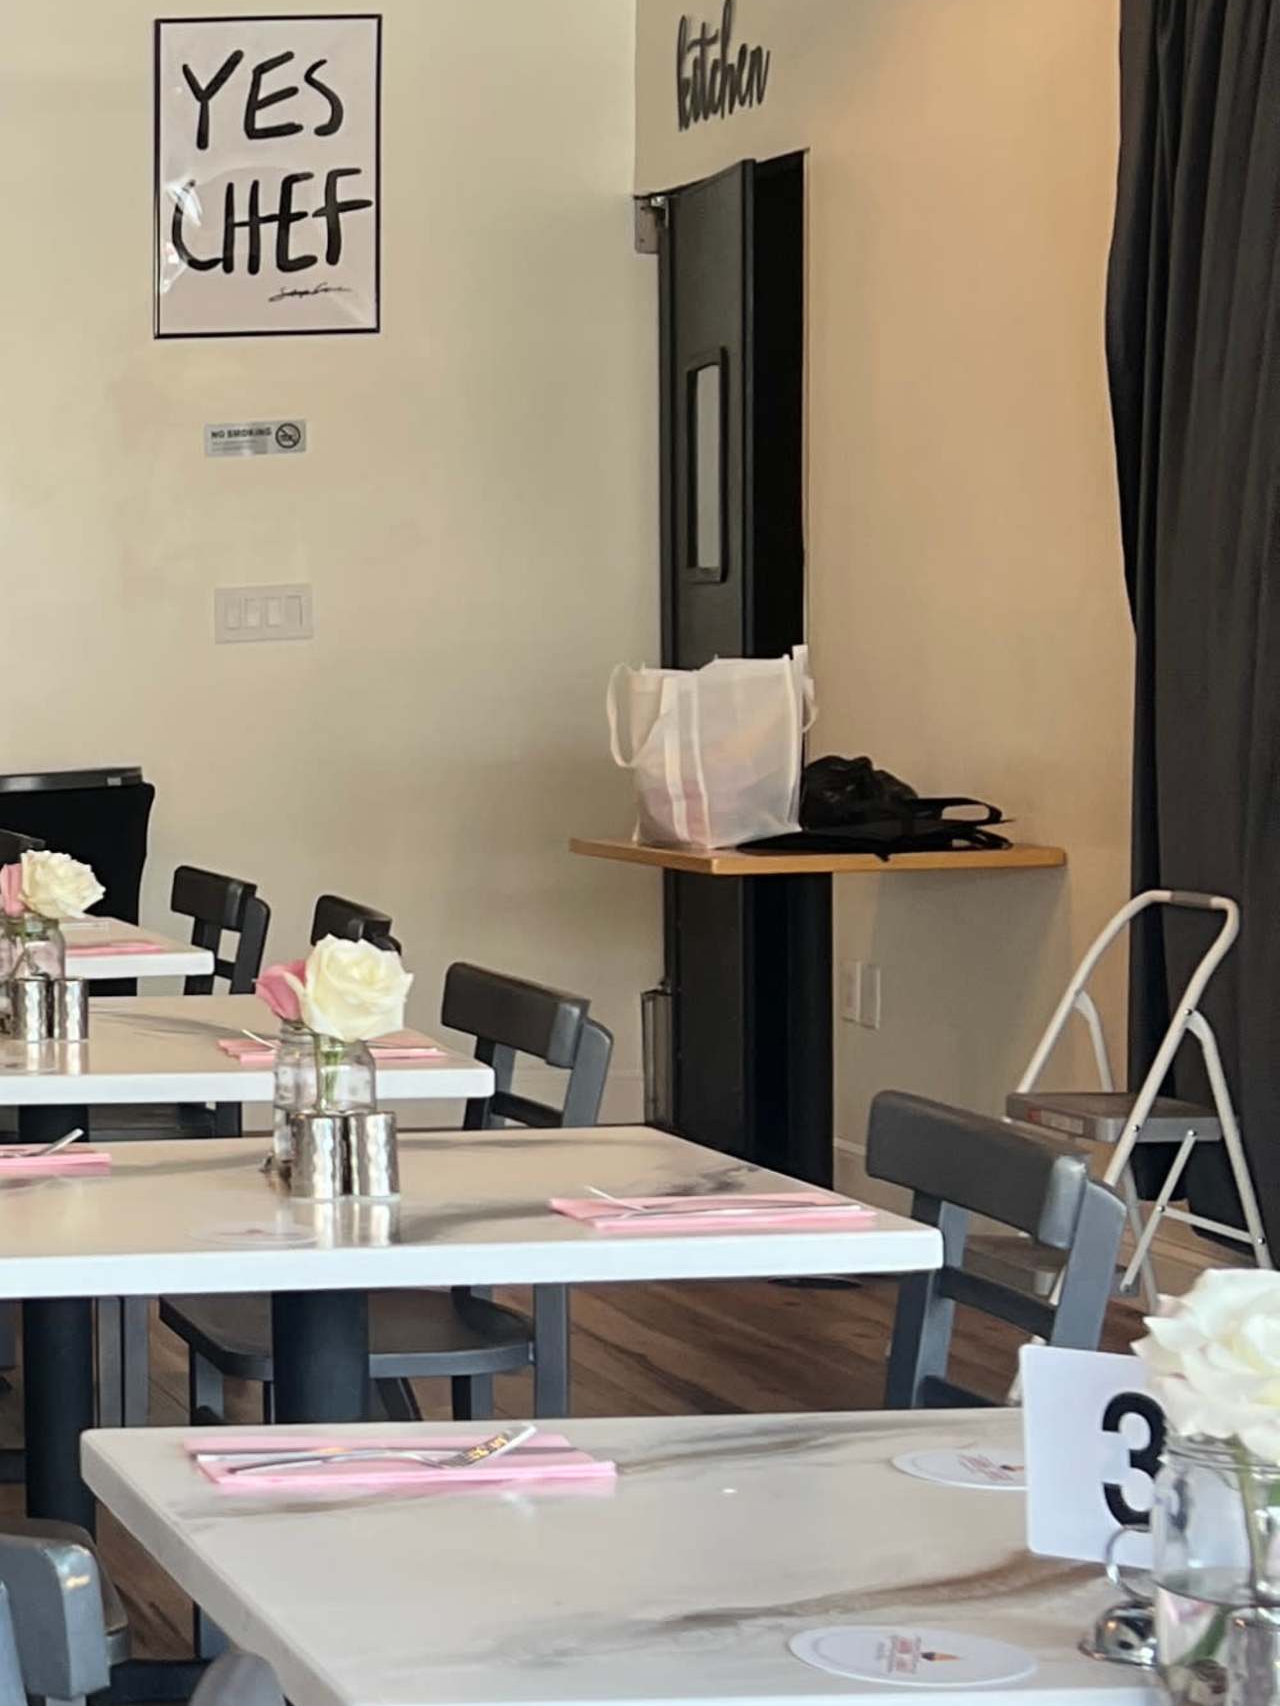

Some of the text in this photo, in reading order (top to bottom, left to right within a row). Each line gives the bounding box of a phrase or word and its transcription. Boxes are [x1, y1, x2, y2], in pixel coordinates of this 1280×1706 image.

[182, 49, 344, 150] YES
[171, 167, 373, 275] CHEF
[211, 427, 272, 439] NO SMOKING
[1101, 1391, 1169, 1533] 3
